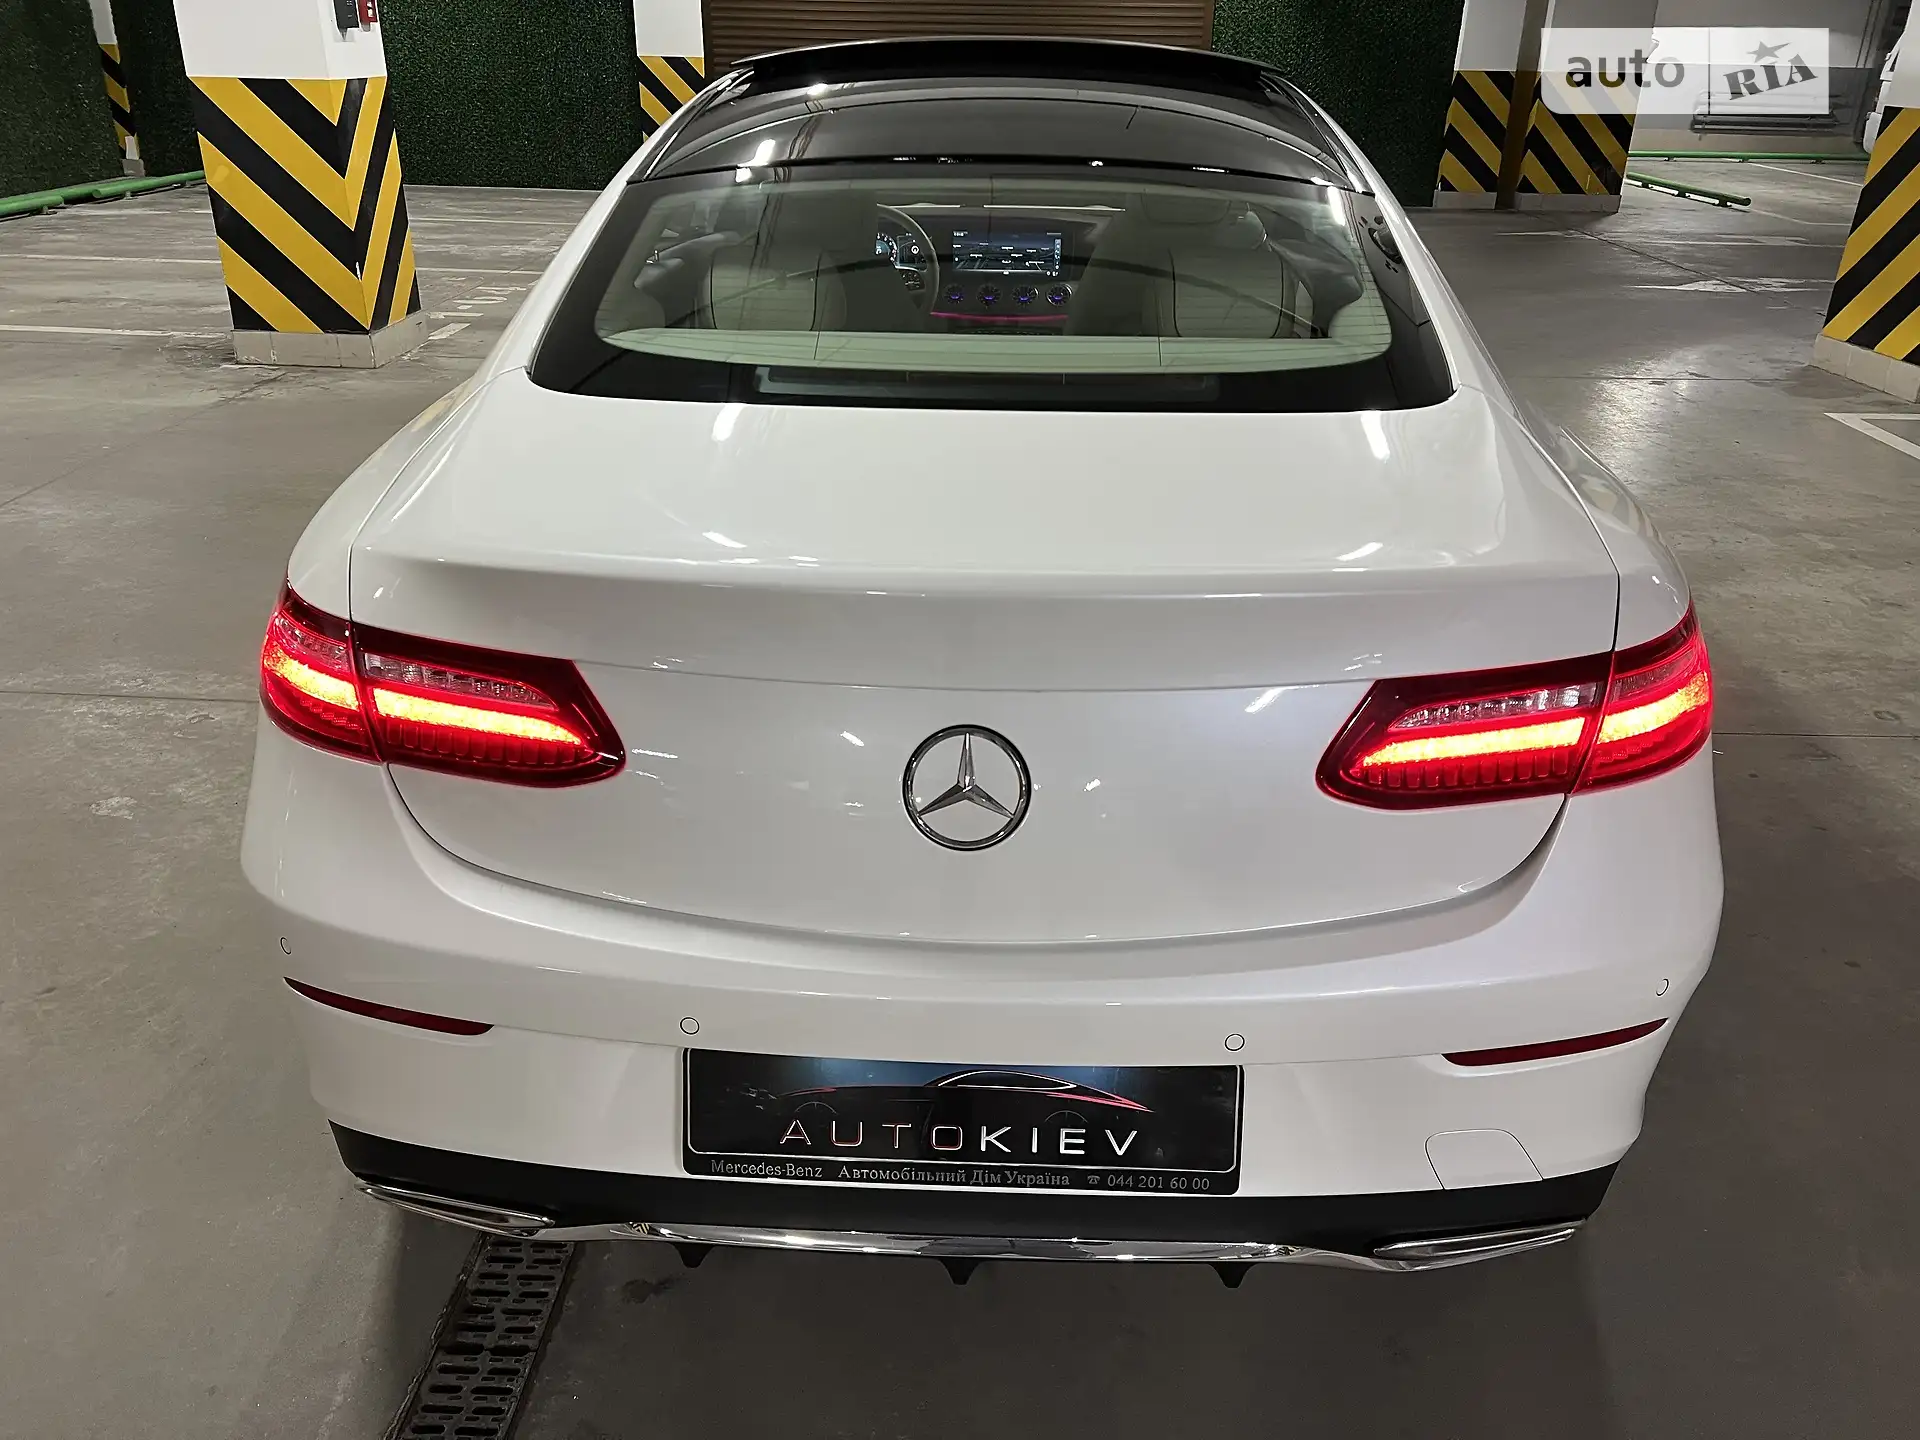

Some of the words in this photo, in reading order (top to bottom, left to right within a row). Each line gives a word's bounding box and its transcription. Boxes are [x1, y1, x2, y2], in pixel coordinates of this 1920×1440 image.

[780, 1118, 1138, 1157] AUTOKIEV
[710, 1159, 823, 1178] Mercedes-Benz
[837, 1165, 967, 1183] Автомобільний
[969, 1169, 1001, 1185] Дім
[1004, 1170, 1070, 1187] Україна
[1107, 1174, 1134, 1187] 044
[1138, 1175, 1164, 1189] 201
[1169, 1176, 1188, 1190] 60
[1192, 1177, 1210, 1190] 00
